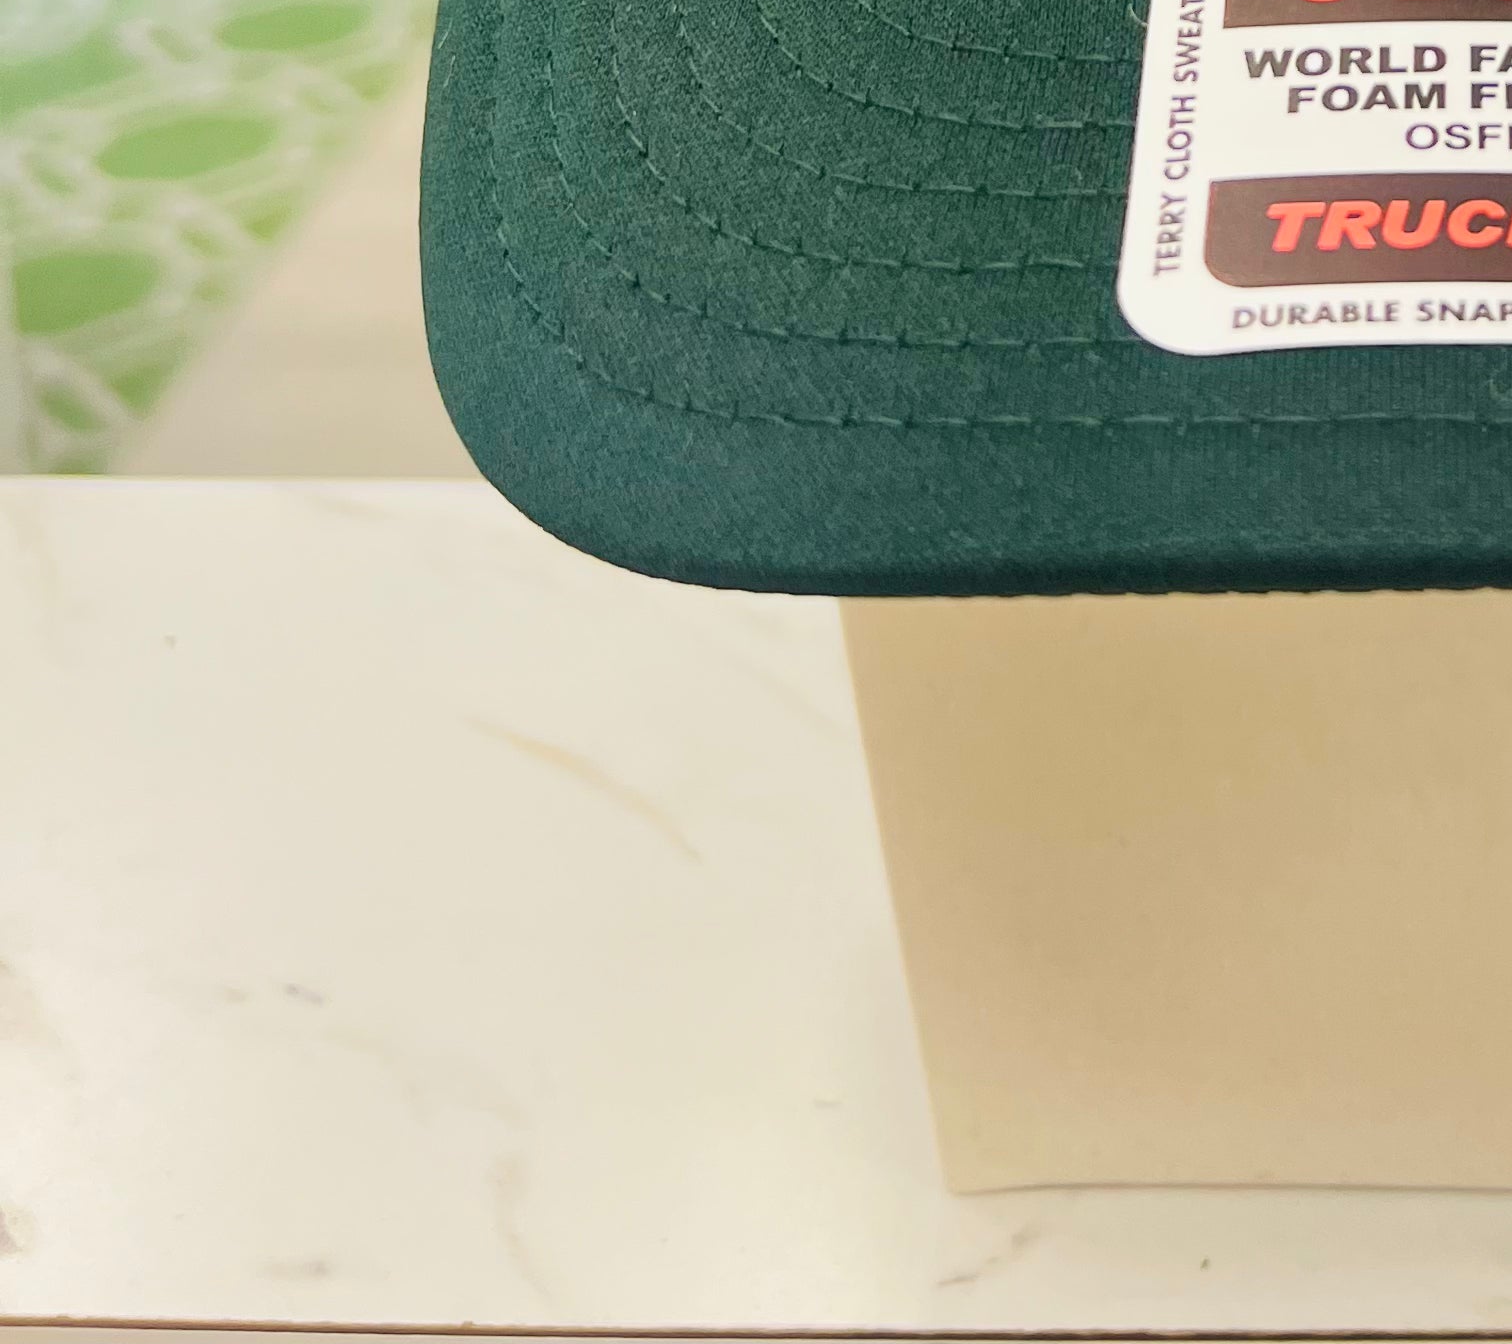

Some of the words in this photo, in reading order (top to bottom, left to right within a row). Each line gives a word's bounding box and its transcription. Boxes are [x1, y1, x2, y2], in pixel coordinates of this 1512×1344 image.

[1244, 44, 1447, 79] WORLD
[1286, 83, 1447, 113] FOAM
[1163, 93, 1196, 180] CLOTH
[1154, 192, 1187, 277] TERRY
[1232, 301, 1400, 330] DURABLE
